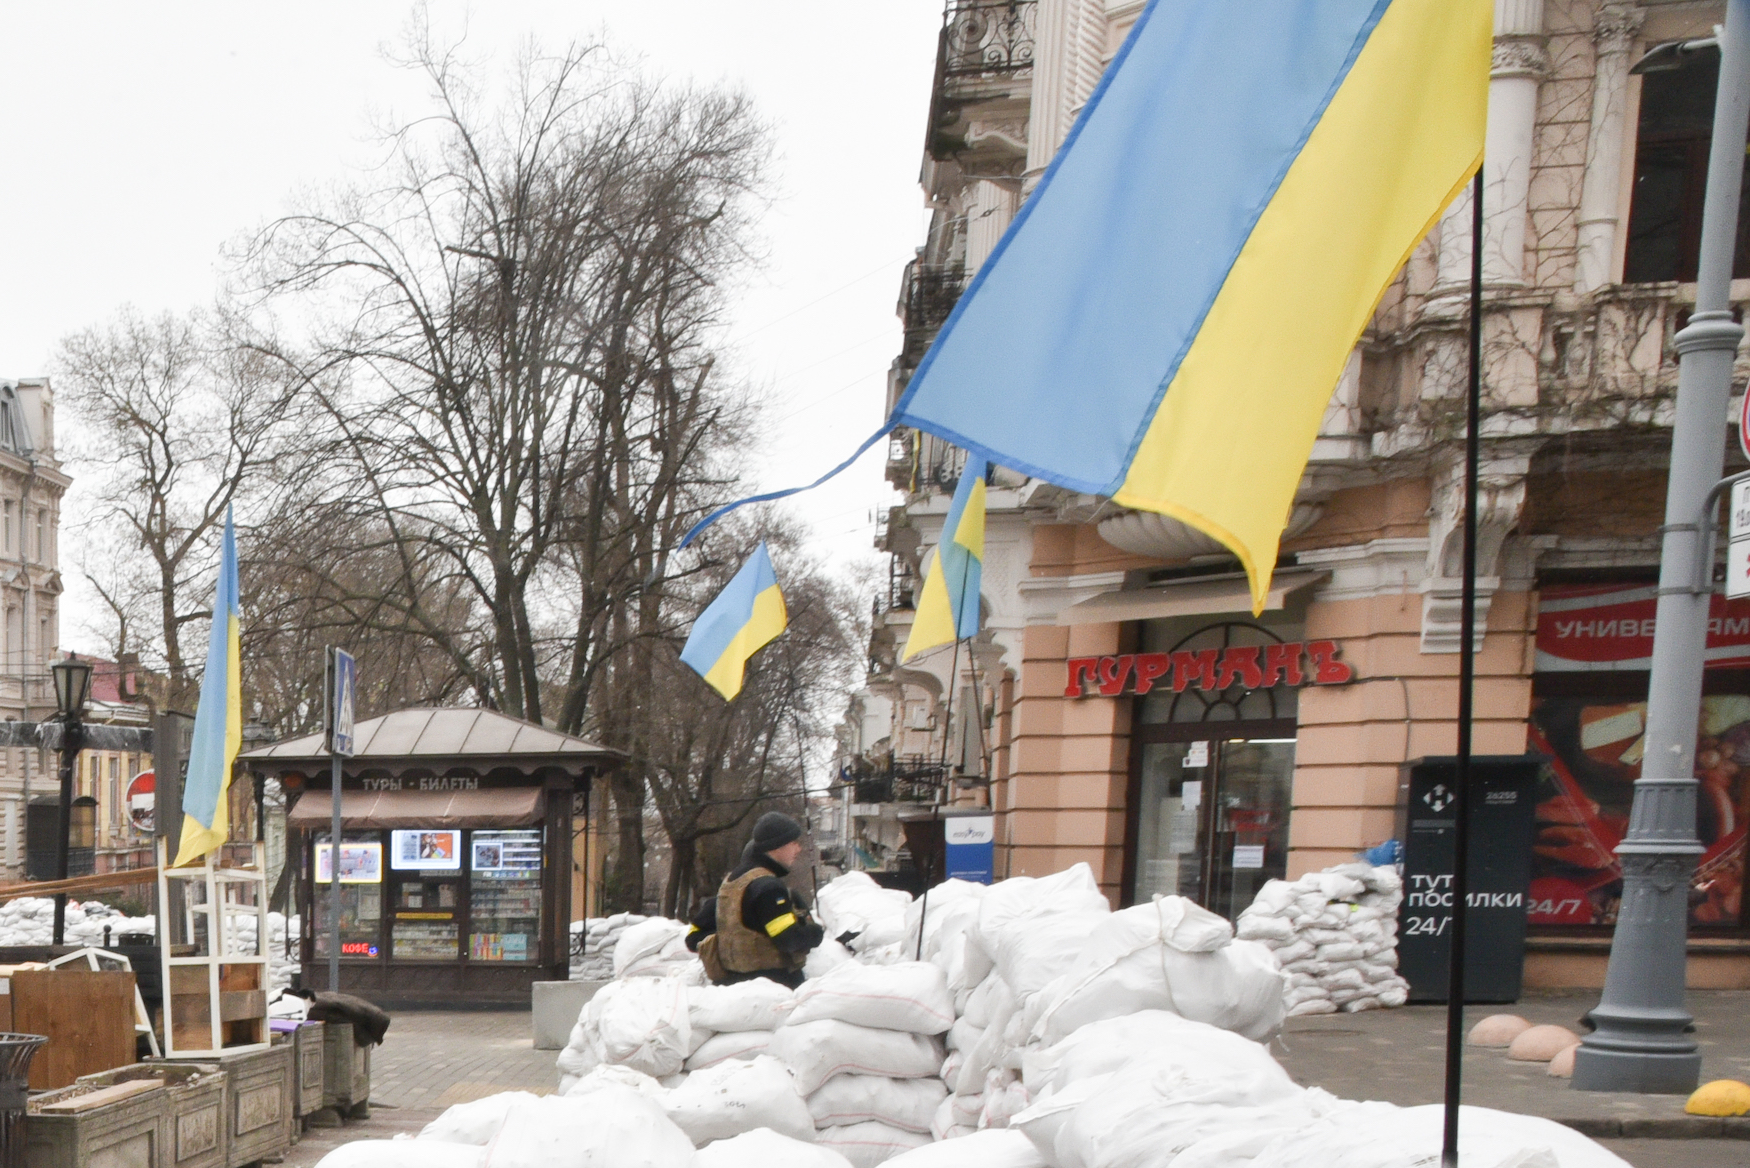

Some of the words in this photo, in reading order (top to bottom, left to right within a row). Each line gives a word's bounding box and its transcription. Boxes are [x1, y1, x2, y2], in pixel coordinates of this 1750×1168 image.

[1554, 617, 1750, 638] УНИВЕАМ
[1064, 641, 1351, 699] ГУРМАНЪ
[1526, 899, 1582, 914] 24/7
[1405, 917, 1453, 936] 24/
[342, 942, 369, 953] КОФЕ
